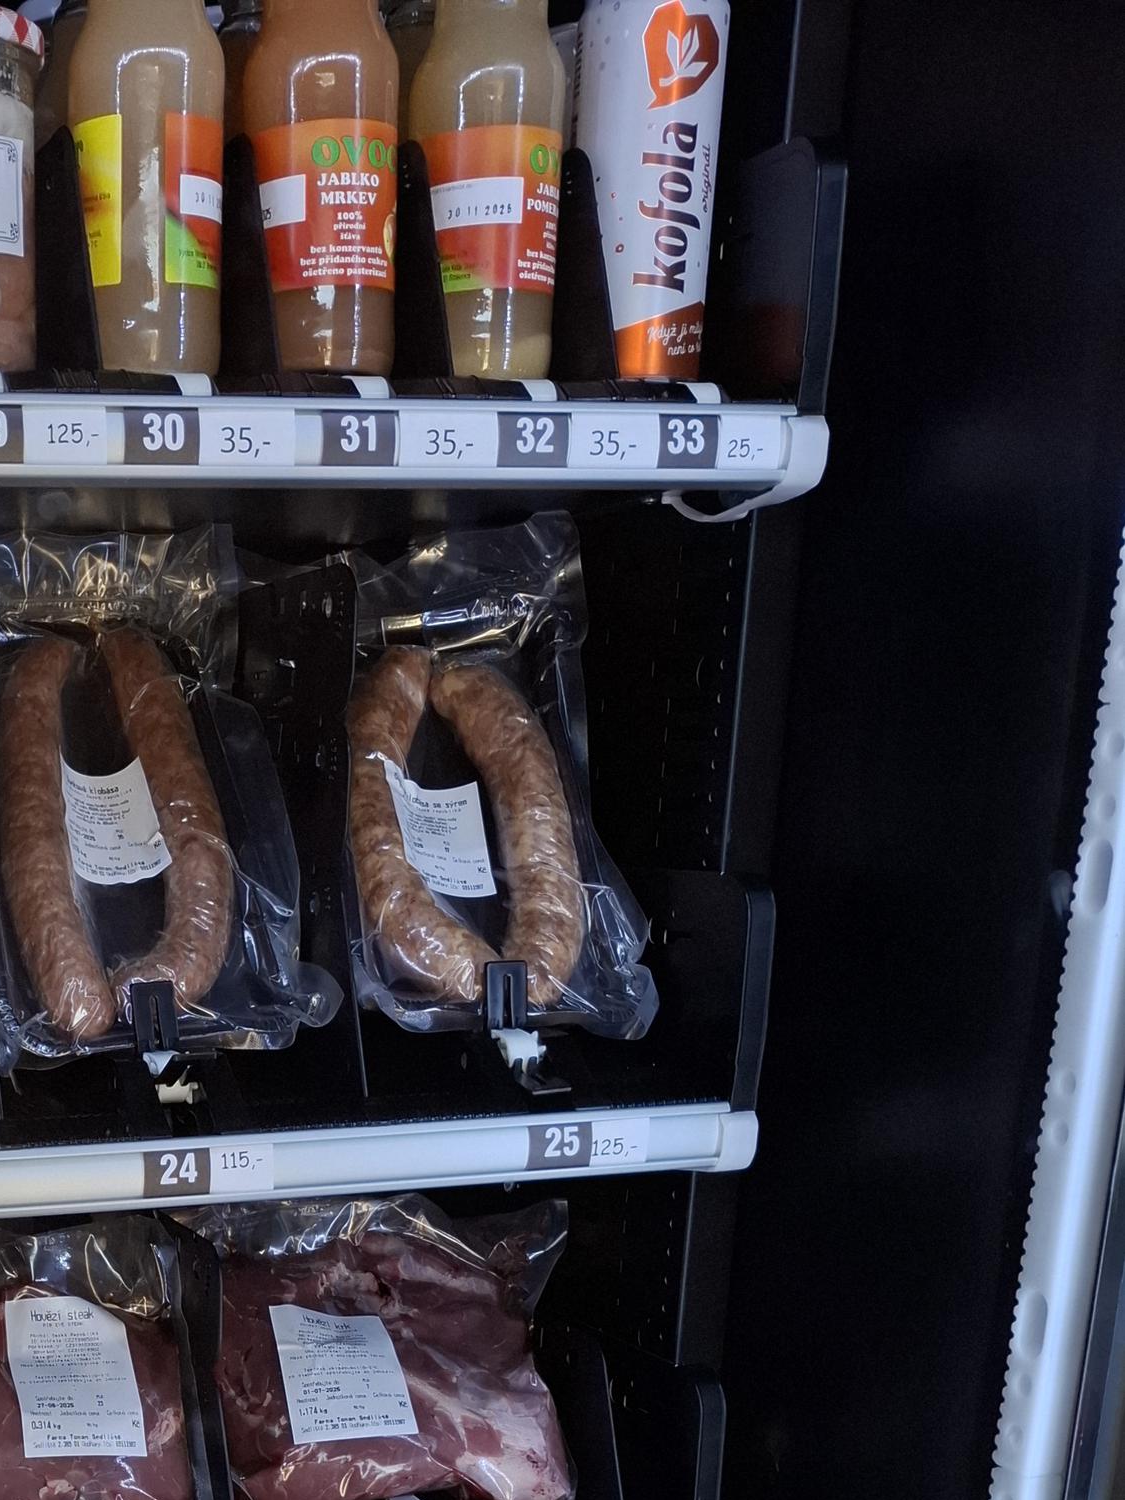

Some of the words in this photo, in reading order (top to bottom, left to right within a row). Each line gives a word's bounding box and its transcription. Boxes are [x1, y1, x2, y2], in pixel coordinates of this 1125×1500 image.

[316, 171, 380, 187] JABLKO
[320, 191, 378, 205] MRKEV
[632, 121, 700, 293] kofola
[337, 211, 363, 220] 100%
[300, 257, 316, 266] bez
[318, 255, 366, 266] přidaného
[310, 245, 326, 254] bez
[47, 423, 99, 448] 125,-
[142, 412, 185, 451] 30
[220, 427, 271, 458] 35,-
[340, 415, 377, 453] 31
[425, 429, 474, 460] 35,-
[516, 417, 555, 454] 32
[589, 429, 637, 460] 35,-
[667, 418, 705, 455] 33
[727, 438, 764, 463] 25,-
[544, 1126, 580, 1158] 25
[592, 1138, 638, 1158] 125,-
[160, 1152, 198, 1185] 24
[221, 1151, 263, 1170] 115,-
[30, 1309, 61, 1323] Hovězí
[68, 1307, 95, 1321] steak
